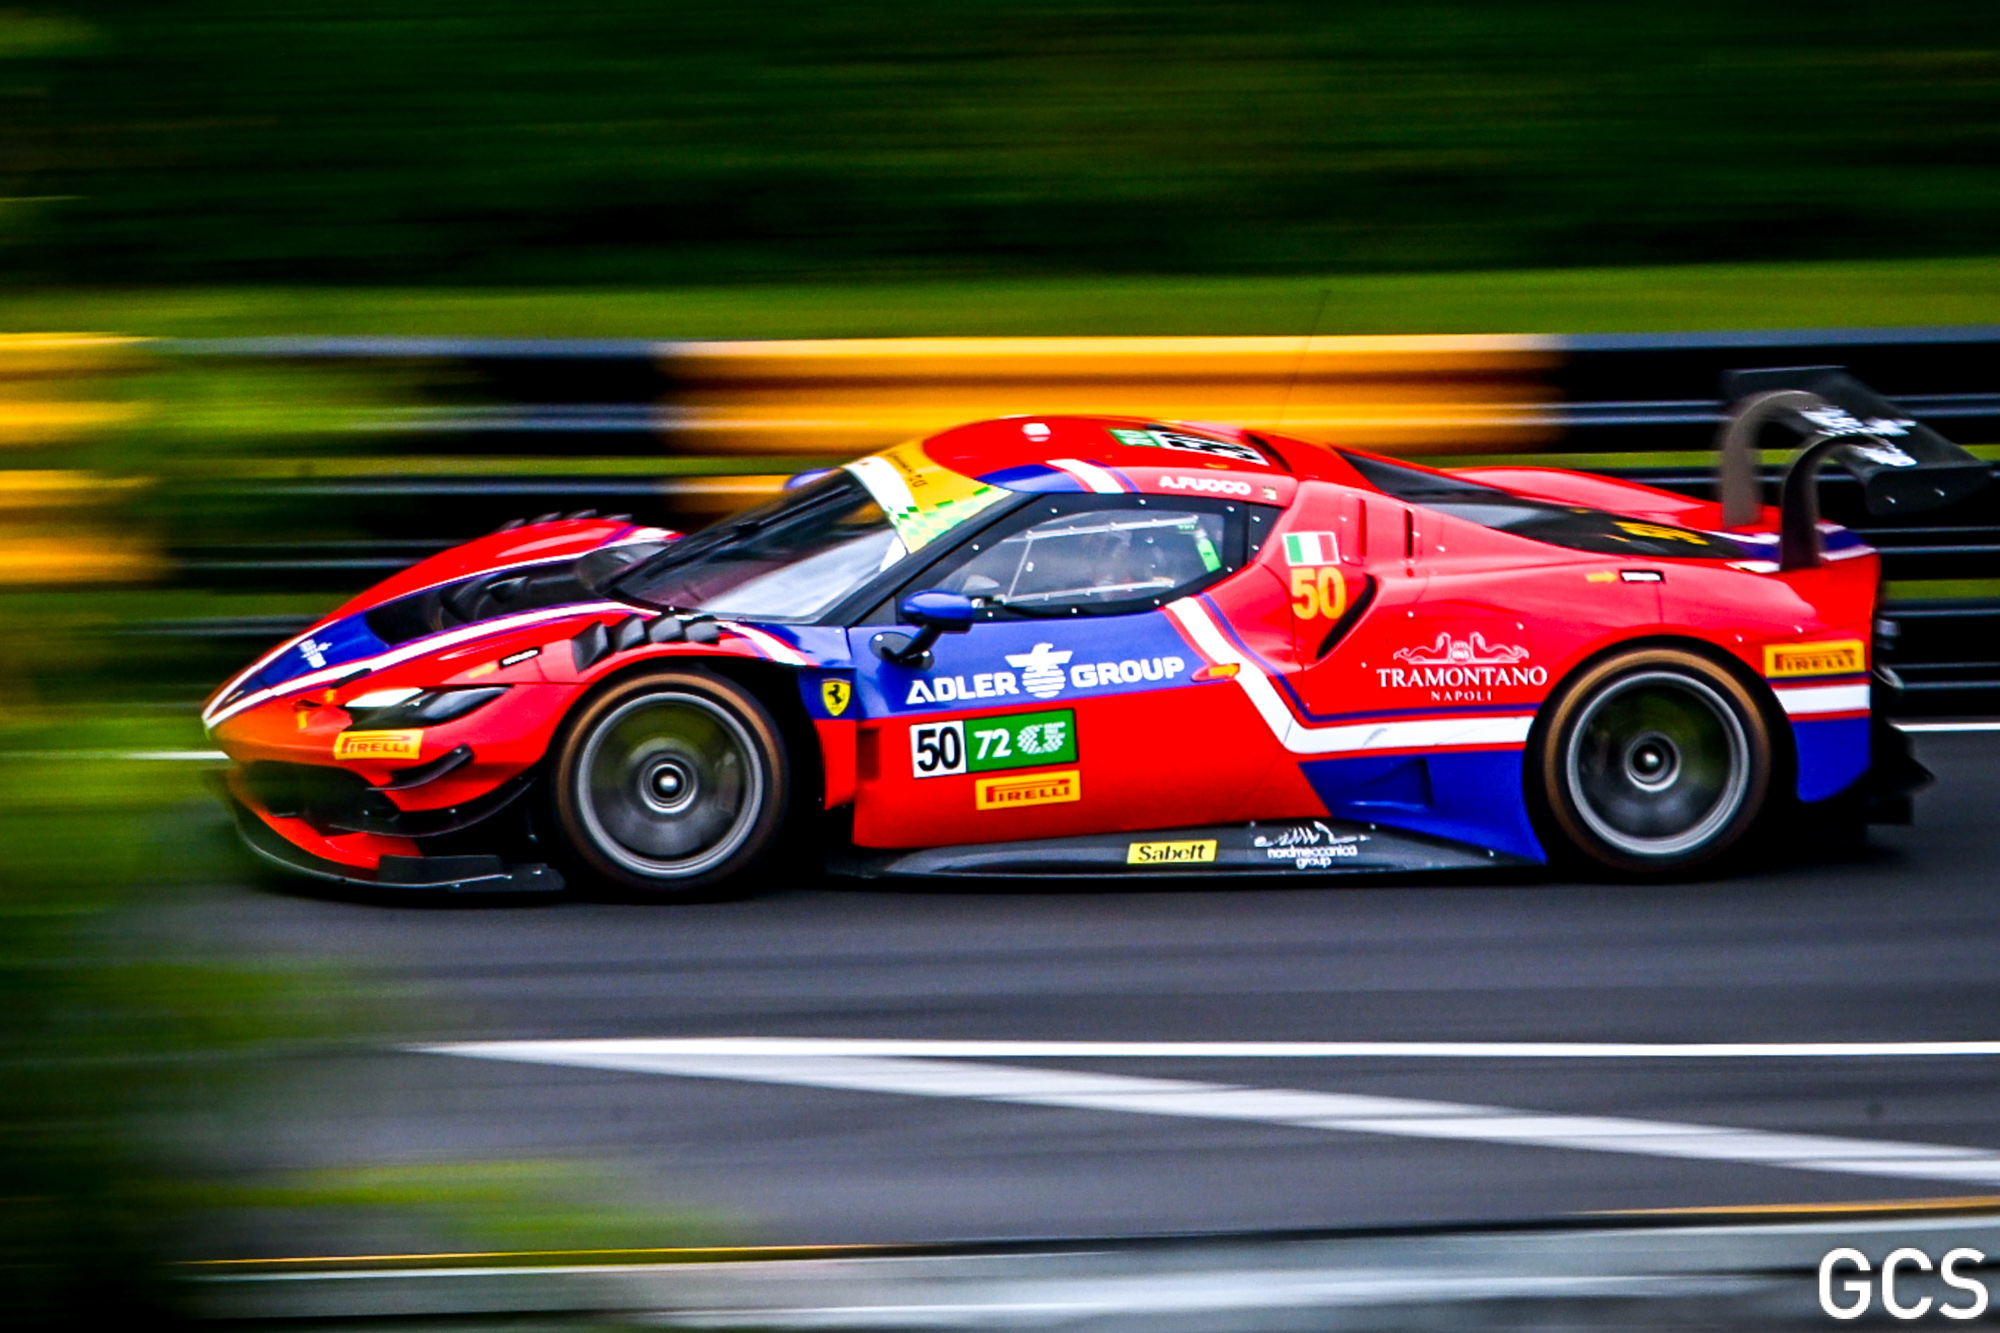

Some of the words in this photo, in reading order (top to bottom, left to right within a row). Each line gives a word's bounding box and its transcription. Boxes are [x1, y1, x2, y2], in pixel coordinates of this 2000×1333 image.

[1158, 475, 1252, 496] A.FUOCO
[1291, 566, 1347, 620] 50
[1774, 648, 1856, 671] PIRELLI
[905, 671, 1020, 705] ADLER
[1069, 656, 1186, 688] GROUP
[1376, 665, 1548, 688] TRAMONTANO
[1430, 690, 1492, 701] NAPOLI
[340, 735, 413, 754] PIRELLI
[916, 726, 962, 773] 50
[973, 728, 1012, 760] 72
[985, 778, 1071, 803] PIRELLI
[1138, 844, 1207, 863] Sabelt
[1267, 844, 1359, 860] nordmeccanica
[1295, 856, 1333, 870] group
